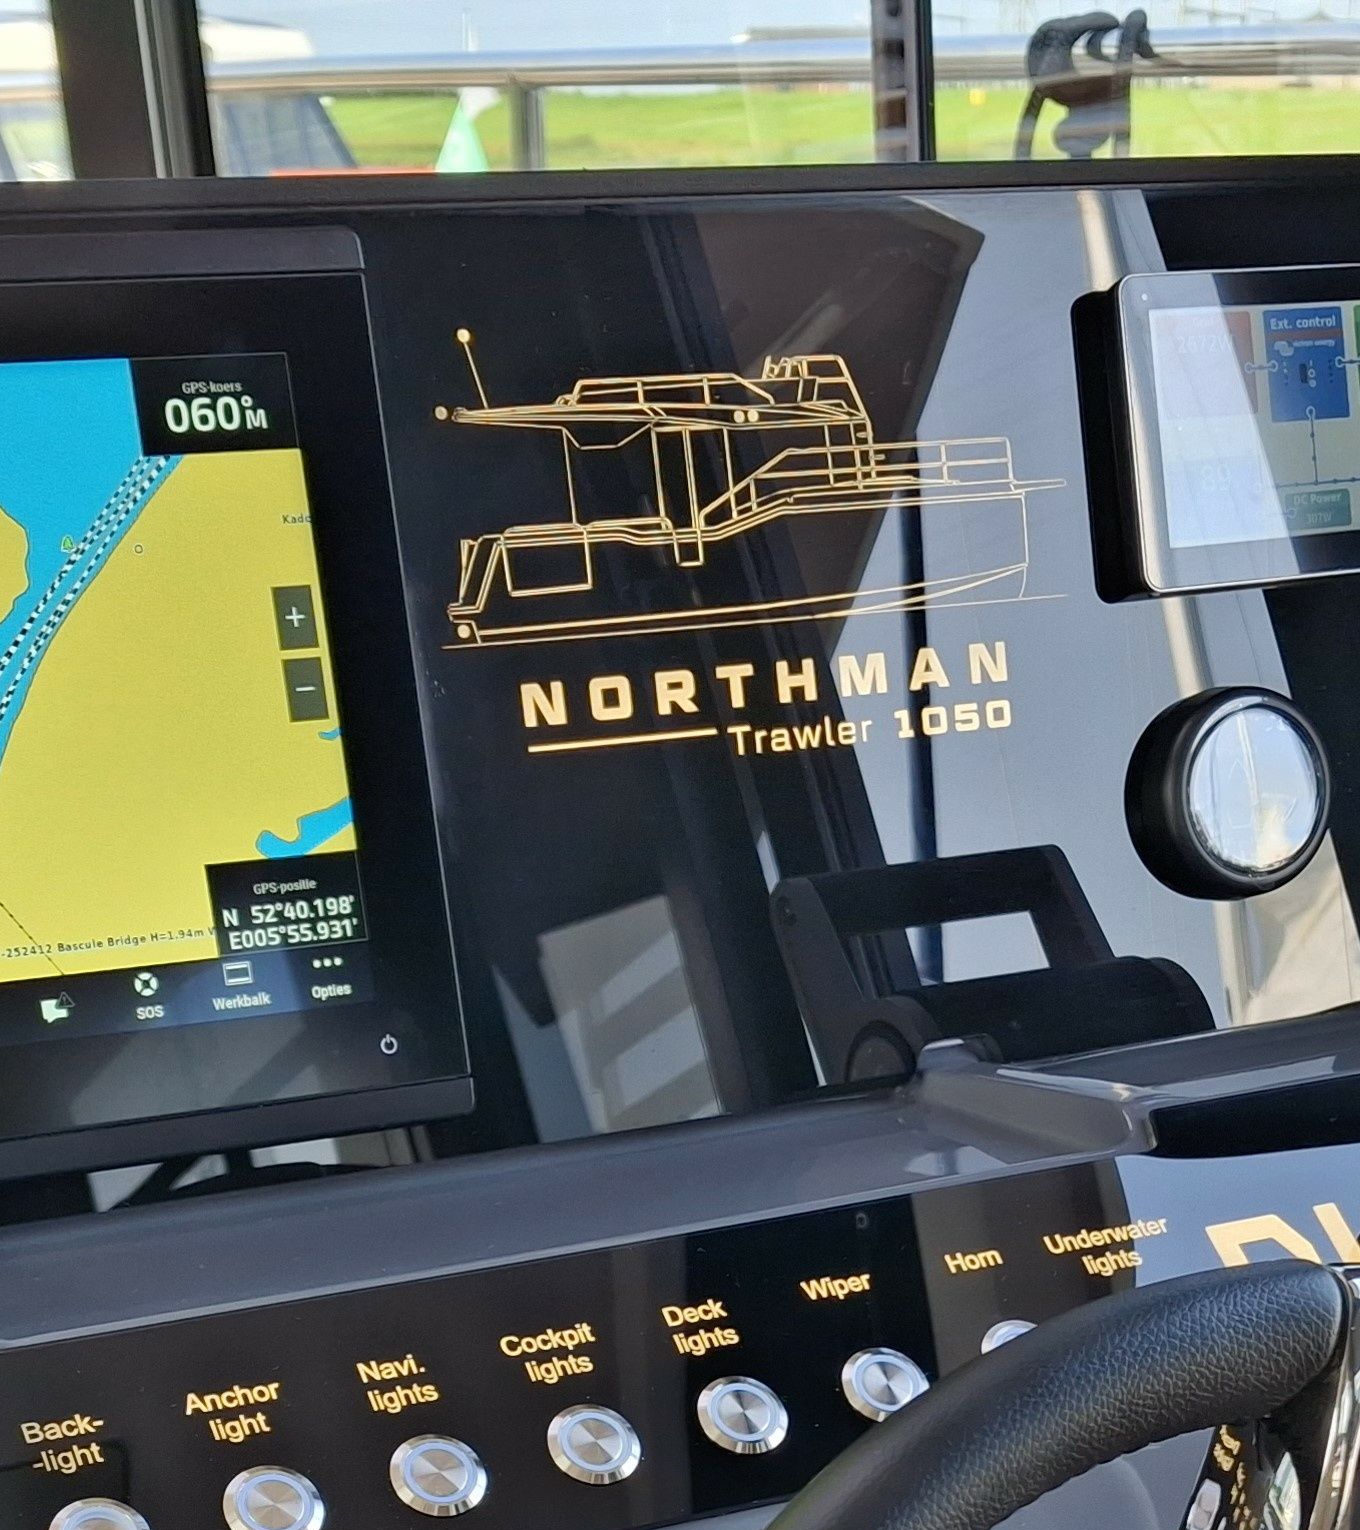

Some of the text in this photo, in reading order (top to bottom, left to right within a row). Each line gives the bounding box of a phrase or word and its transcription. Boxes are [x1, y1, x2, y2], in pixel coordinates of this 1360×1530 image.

[1269, 314, 1337, 330] Ext. control
[181, 381, 243, 395] GPS-koers
[1309, 492, 1342, 505] Power
[519, 641, 1009, 729] NORTHMAN
[726, 699, 1013, 757] Trawler 1050
[252, 878, 318, 896] GPS-positie
[221, 908, 240, 928] N
[57, 940, 104, 953] Bascule
[106, 934, 147, 948] Bridge
[150, 928, 204, 942] H=1.94m
[212, 991, 273, 1011] Werkbalk
[310, 983, 353, 1001] Opties
[135, 1004, 165, 1021] SOS
[1042, 1217, 1169, 1256] Underwater
[944, 1248, 1004, 1274] Horn
[1081, 1248, 1143, 1278] lights
[799, 1271, 872, 1301] Wiper
[661, 1298, 728, 1328] Deck
[498, 1321, 597, 1358] Cockpit
[672, 1324, 740, 1357] lights
[355, 1353, 427, 1384] Navi.
[524, 1353, 594, 1385] lights
[184, 1380, 282, 1417] Anchor
[366, 1381, 440, 1417] lights
[19, 1414, 105, 1445] Back-
[208, 1411, 271, 1443] light
[32, 1442, 105, 1475] -light
